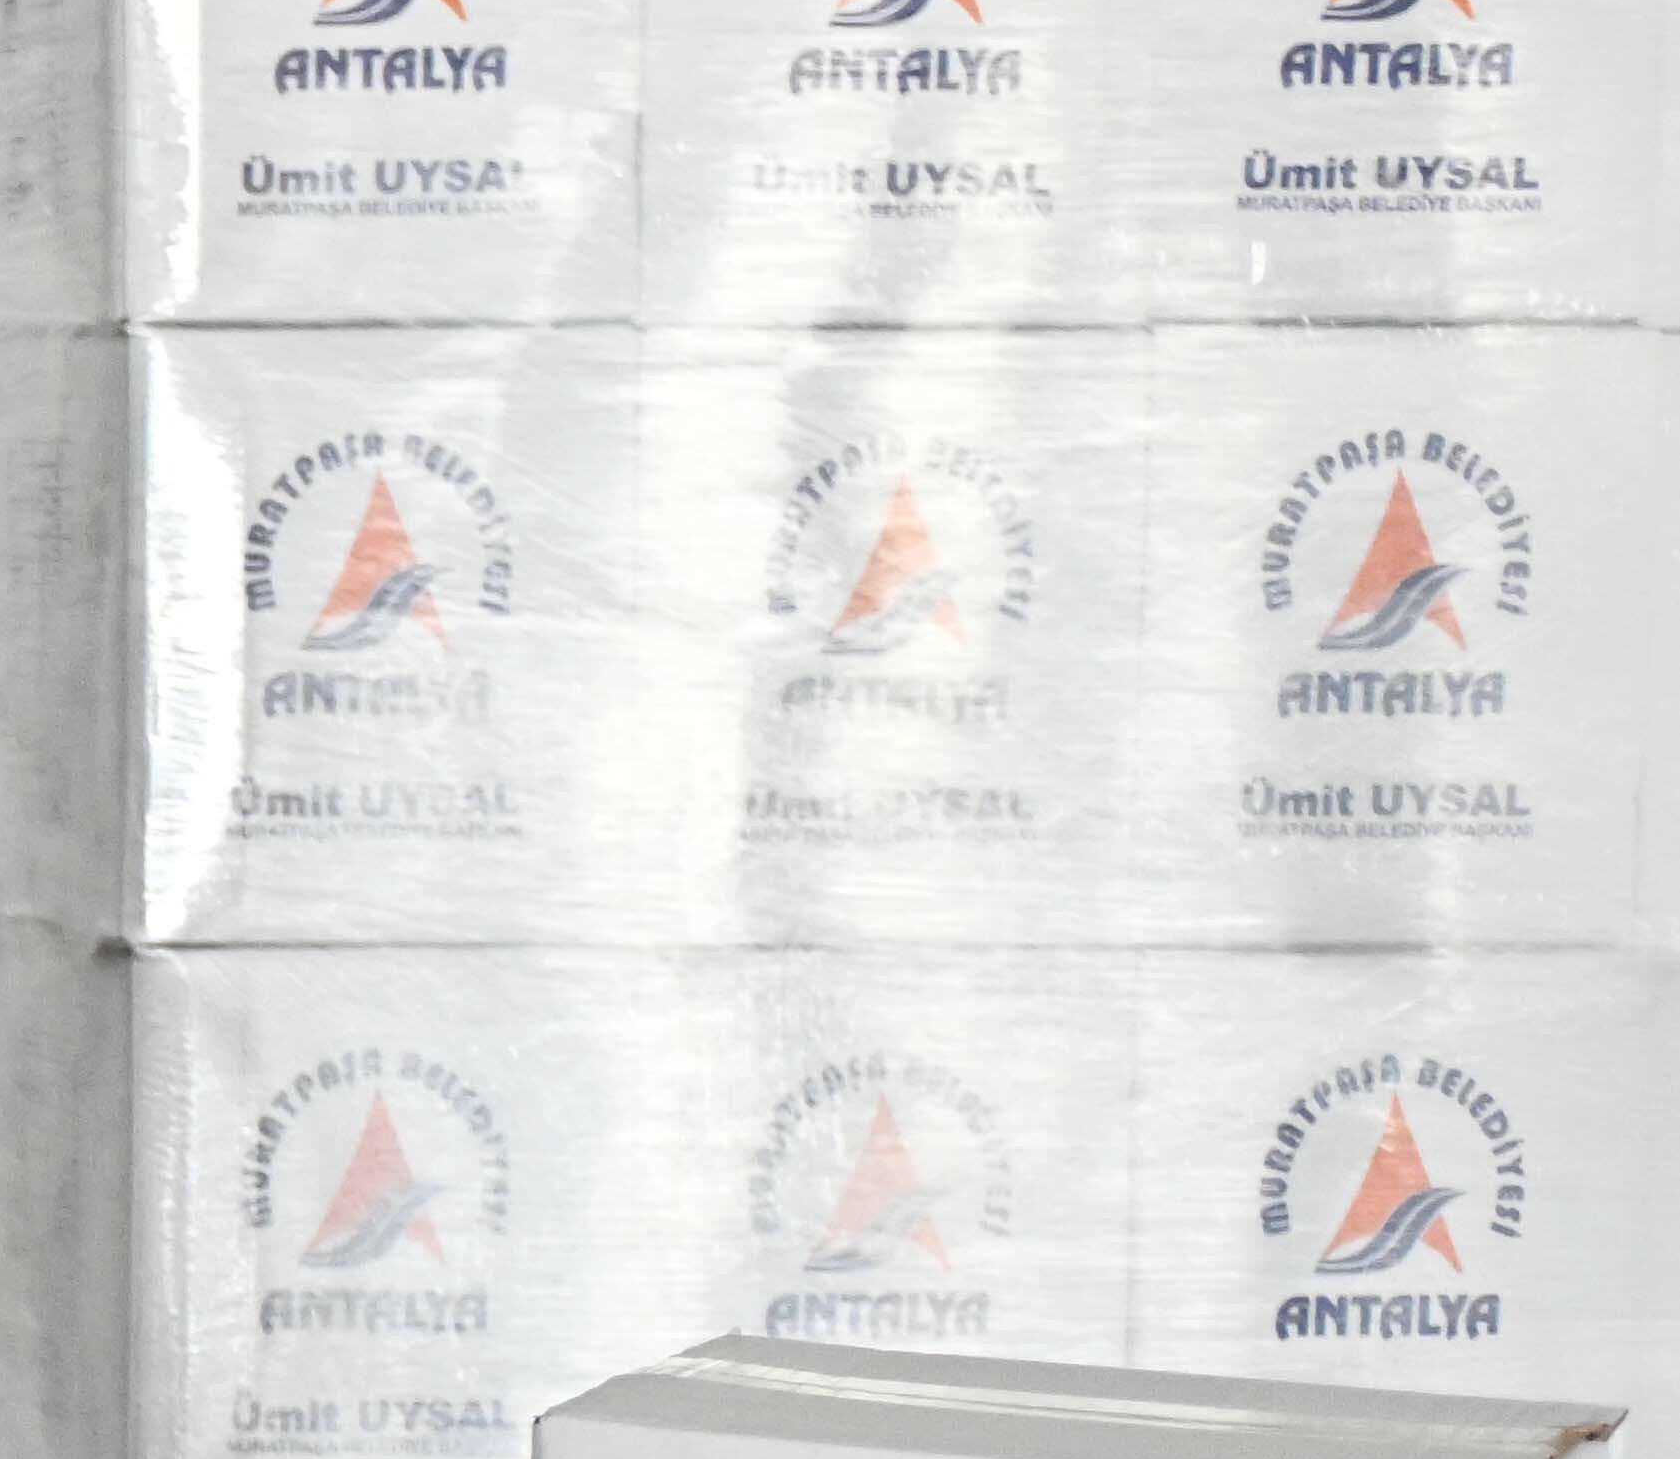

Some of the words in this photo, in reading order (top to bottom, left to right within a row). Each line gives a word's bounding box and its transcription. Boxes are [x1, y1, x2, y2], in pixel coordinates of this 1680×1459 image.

[275, 44, 507, 95] ANTALYA
[789, 47, 1022, 96] ANTALYA
[1281, 42, 1513, 90] ANTALYA
[242, 152, 356, 195] Ümit
[887, 162, 1050, 197] UYSAL
[1244, 148, 1358, 190] Ümit
[1377, 157, 1539, 191] UYSAL
[1278, 671, 1504, 718] ANTALYA
[1243, 776, 1354, 817] Ümit
[1373, 784, 1531, 818] UYSAL
[1260, 1056, 1401, 1236] MURATPAŞA
[1277, 1292, 1499, 1341] ANTALYA
